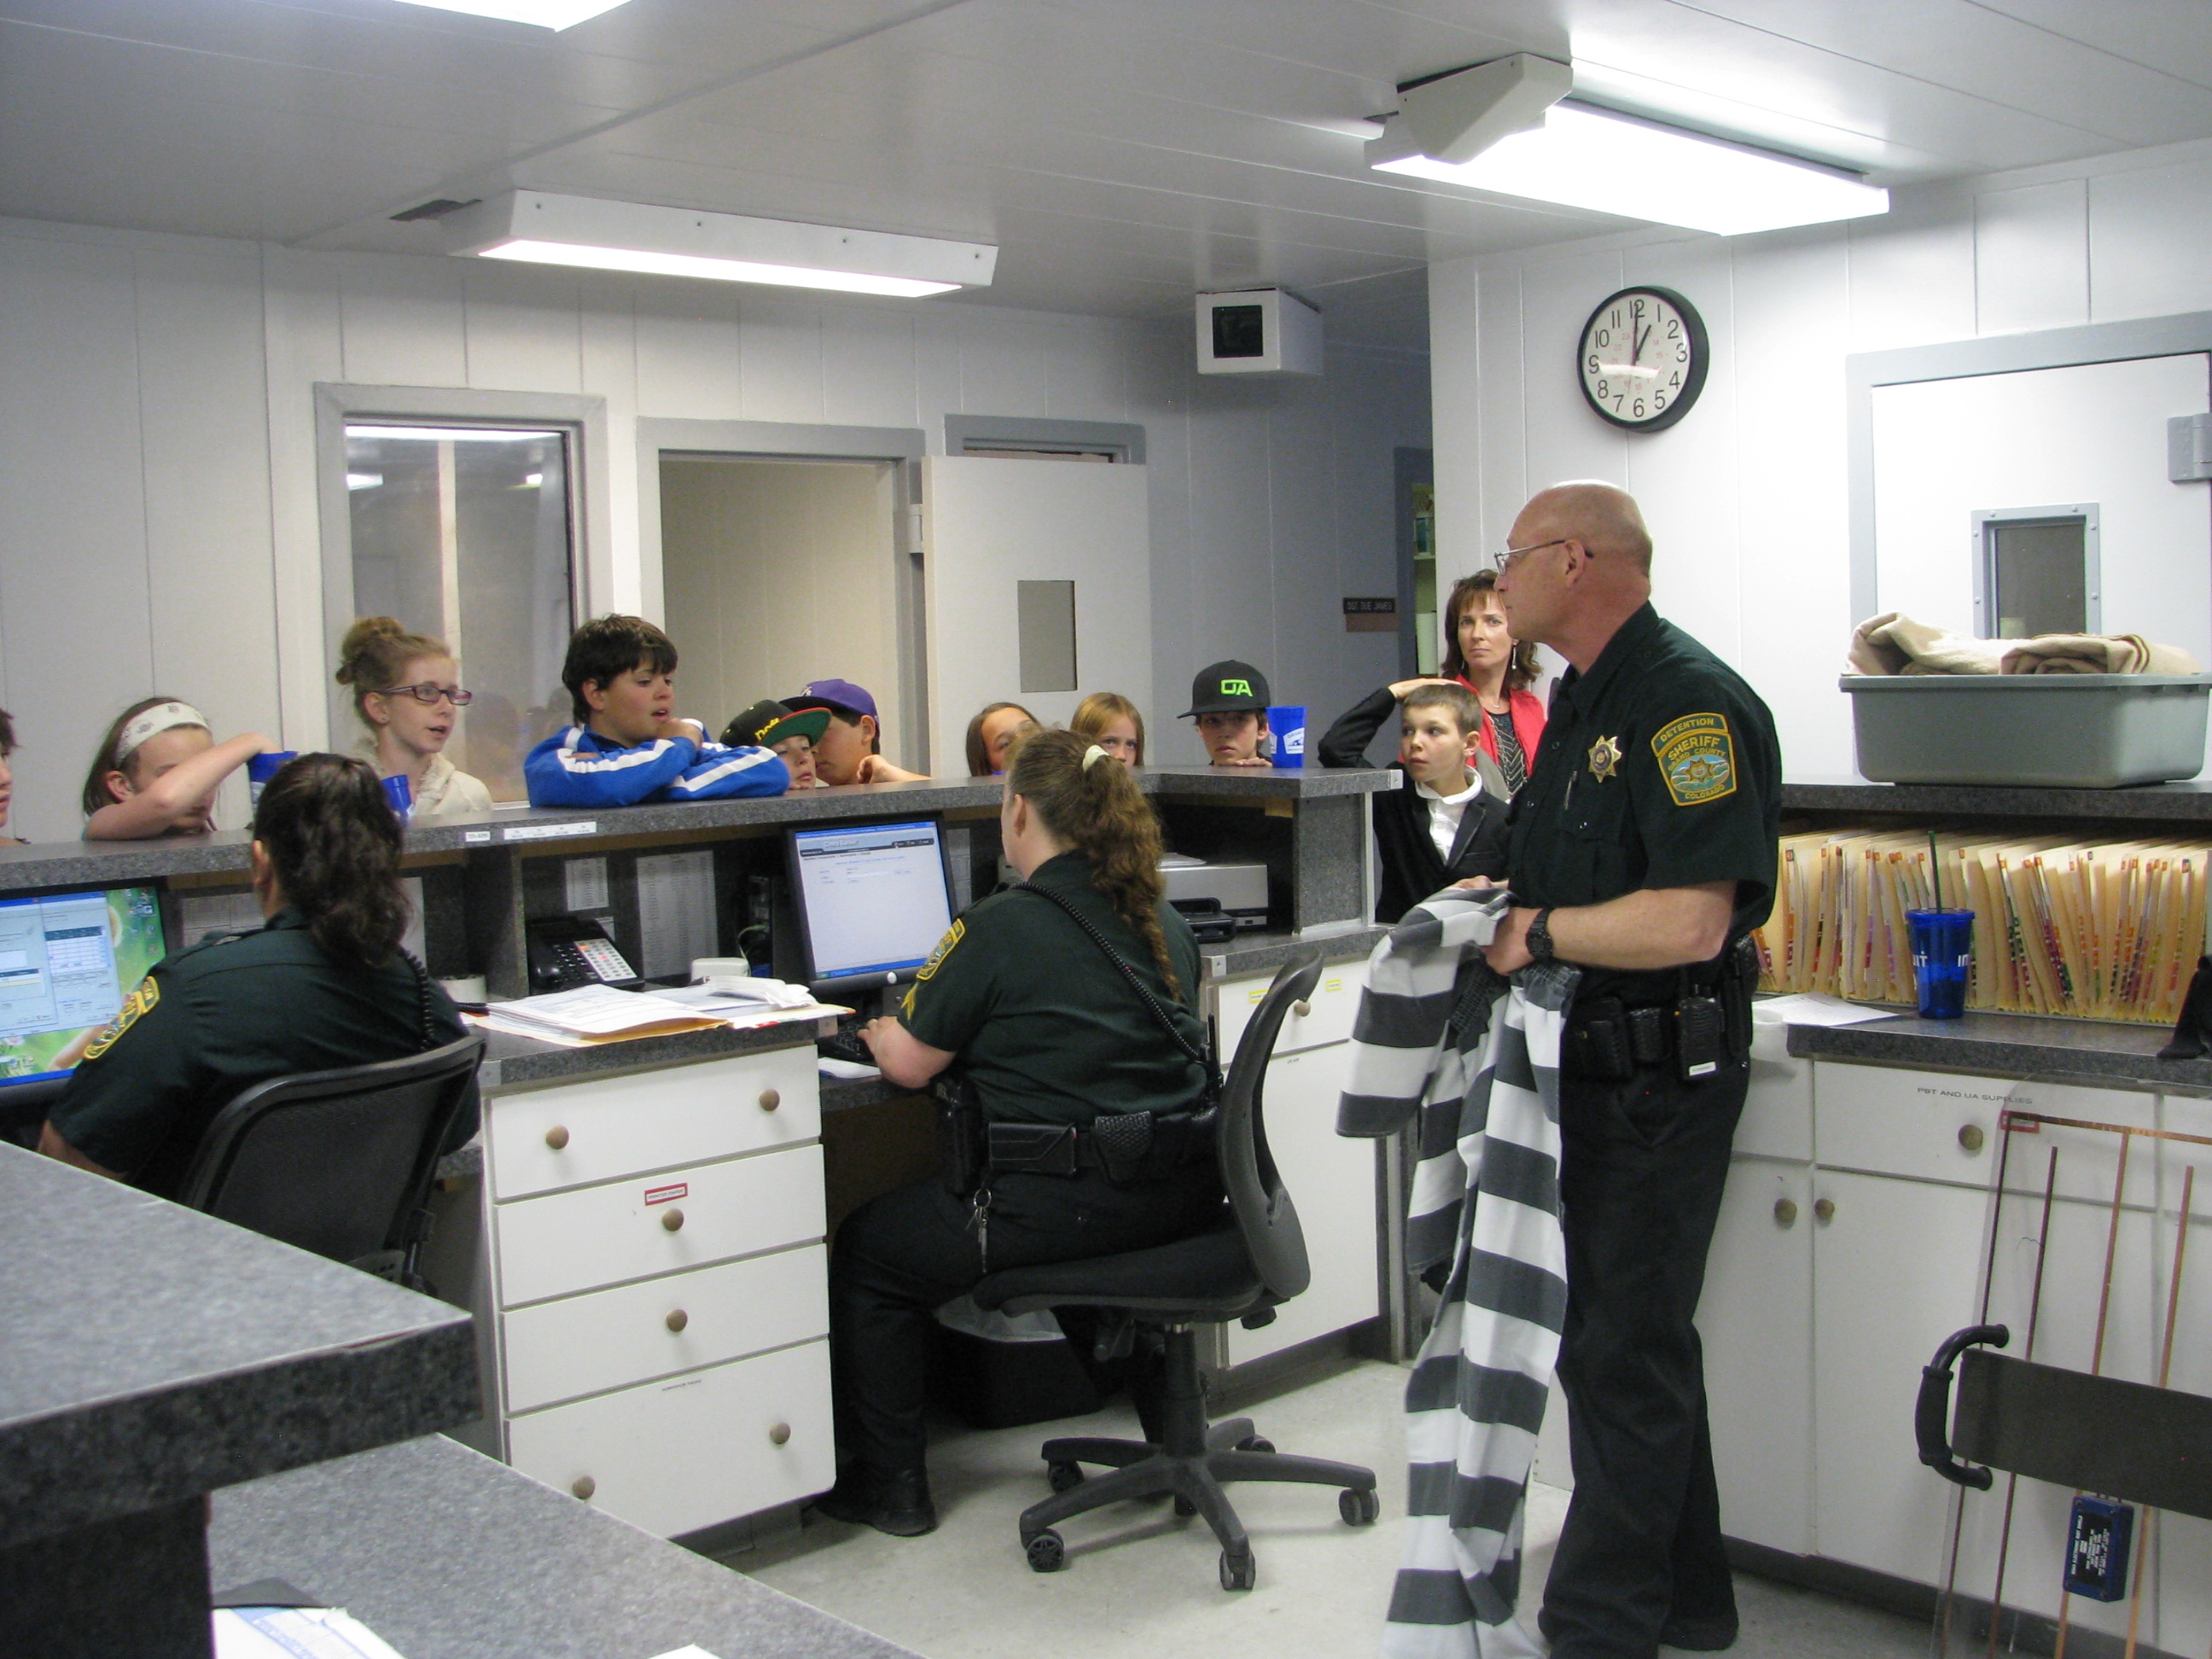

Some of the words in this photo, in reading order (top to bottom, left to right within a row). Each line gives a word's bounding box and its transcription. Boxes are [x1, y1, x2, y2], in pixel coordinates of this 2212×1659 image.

[1630, 300, 1644, 319] 12
[1657, 304, 1661, 323] 1
[1612, 310, 1621, 329] 11
[1595, 329, 1610, 349] 10
[1668, 319, 1679, 340] 2
[1676, 343, 1687, 363] 3
[1589, 354, 1599, 375] 9
[1598, 380, 1609, 399] 8
[1669, 370, 1680, 390] 4
[1613, 394, 1624, 412] 7
[1633, 398, 1644, 417] 6
[1655, 389, 1666, 410] 5
[1660, 718, 1714, 742] DETENTION
[1668, 736, 1720, 760] SHERIFF
[1694, 748, 1726, 757] COUNTY
[1685, 784, 1725, 800] COLORADO
[1982, 1094, 2034, 1104] SUPPLIES
